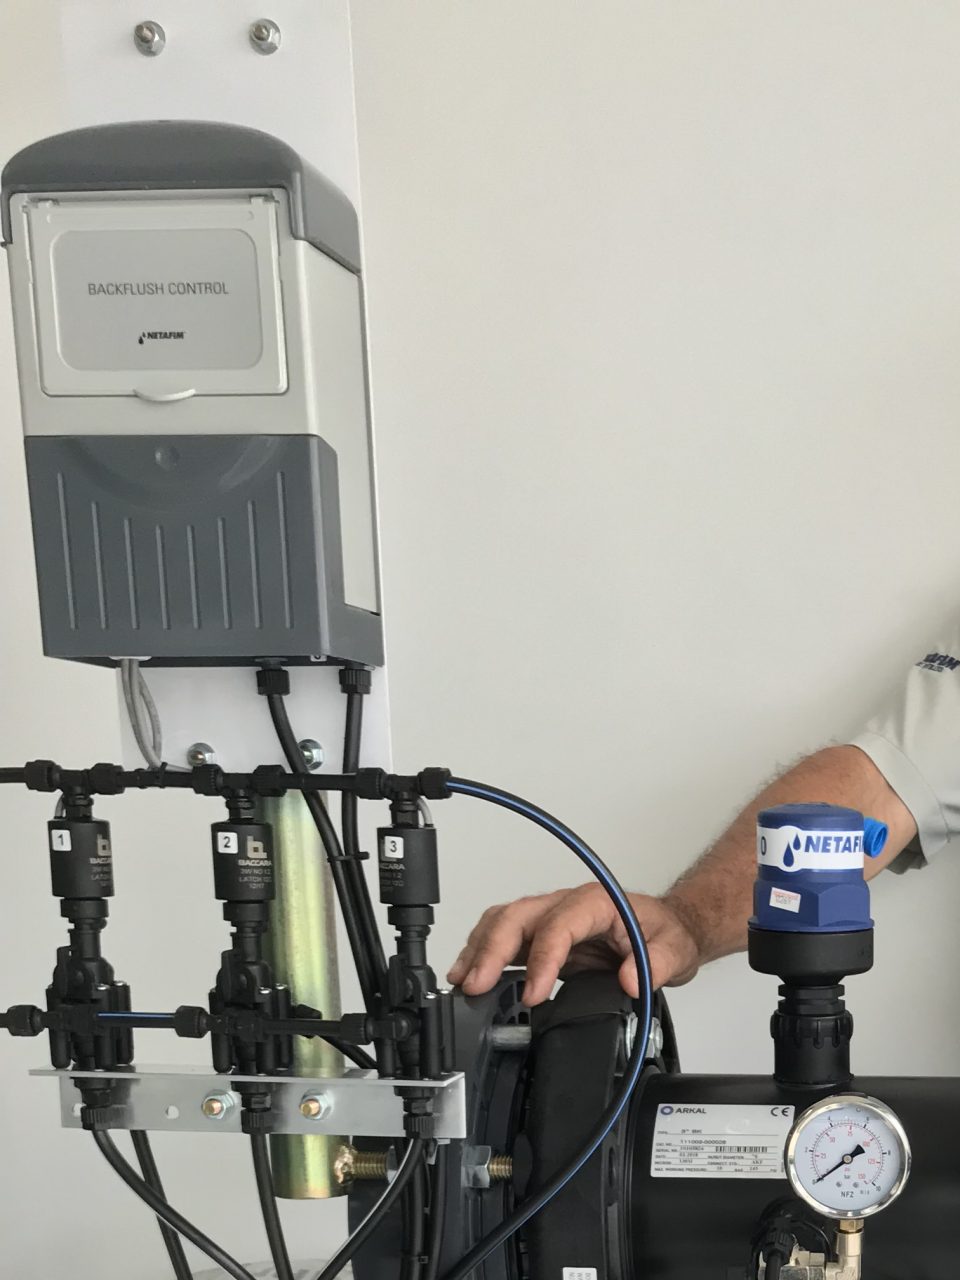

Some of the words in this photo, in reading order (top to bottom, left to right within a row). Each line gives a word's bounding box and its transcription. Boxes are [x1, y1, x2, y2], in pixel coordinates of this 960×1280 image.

[87, 283, 164, 296] BACKFLUSH
[167, 281, 229, 295] CONTROL
[147, 331, 184, 340] NETAFIM
[57, 833, 64, 847] 1
[223, 836, 231, 849] 2
[389, 840, 397, 853] 3
[804, 835, 864, 853] NETAFI
[675, 1107, 707, 1115] ARKAL
